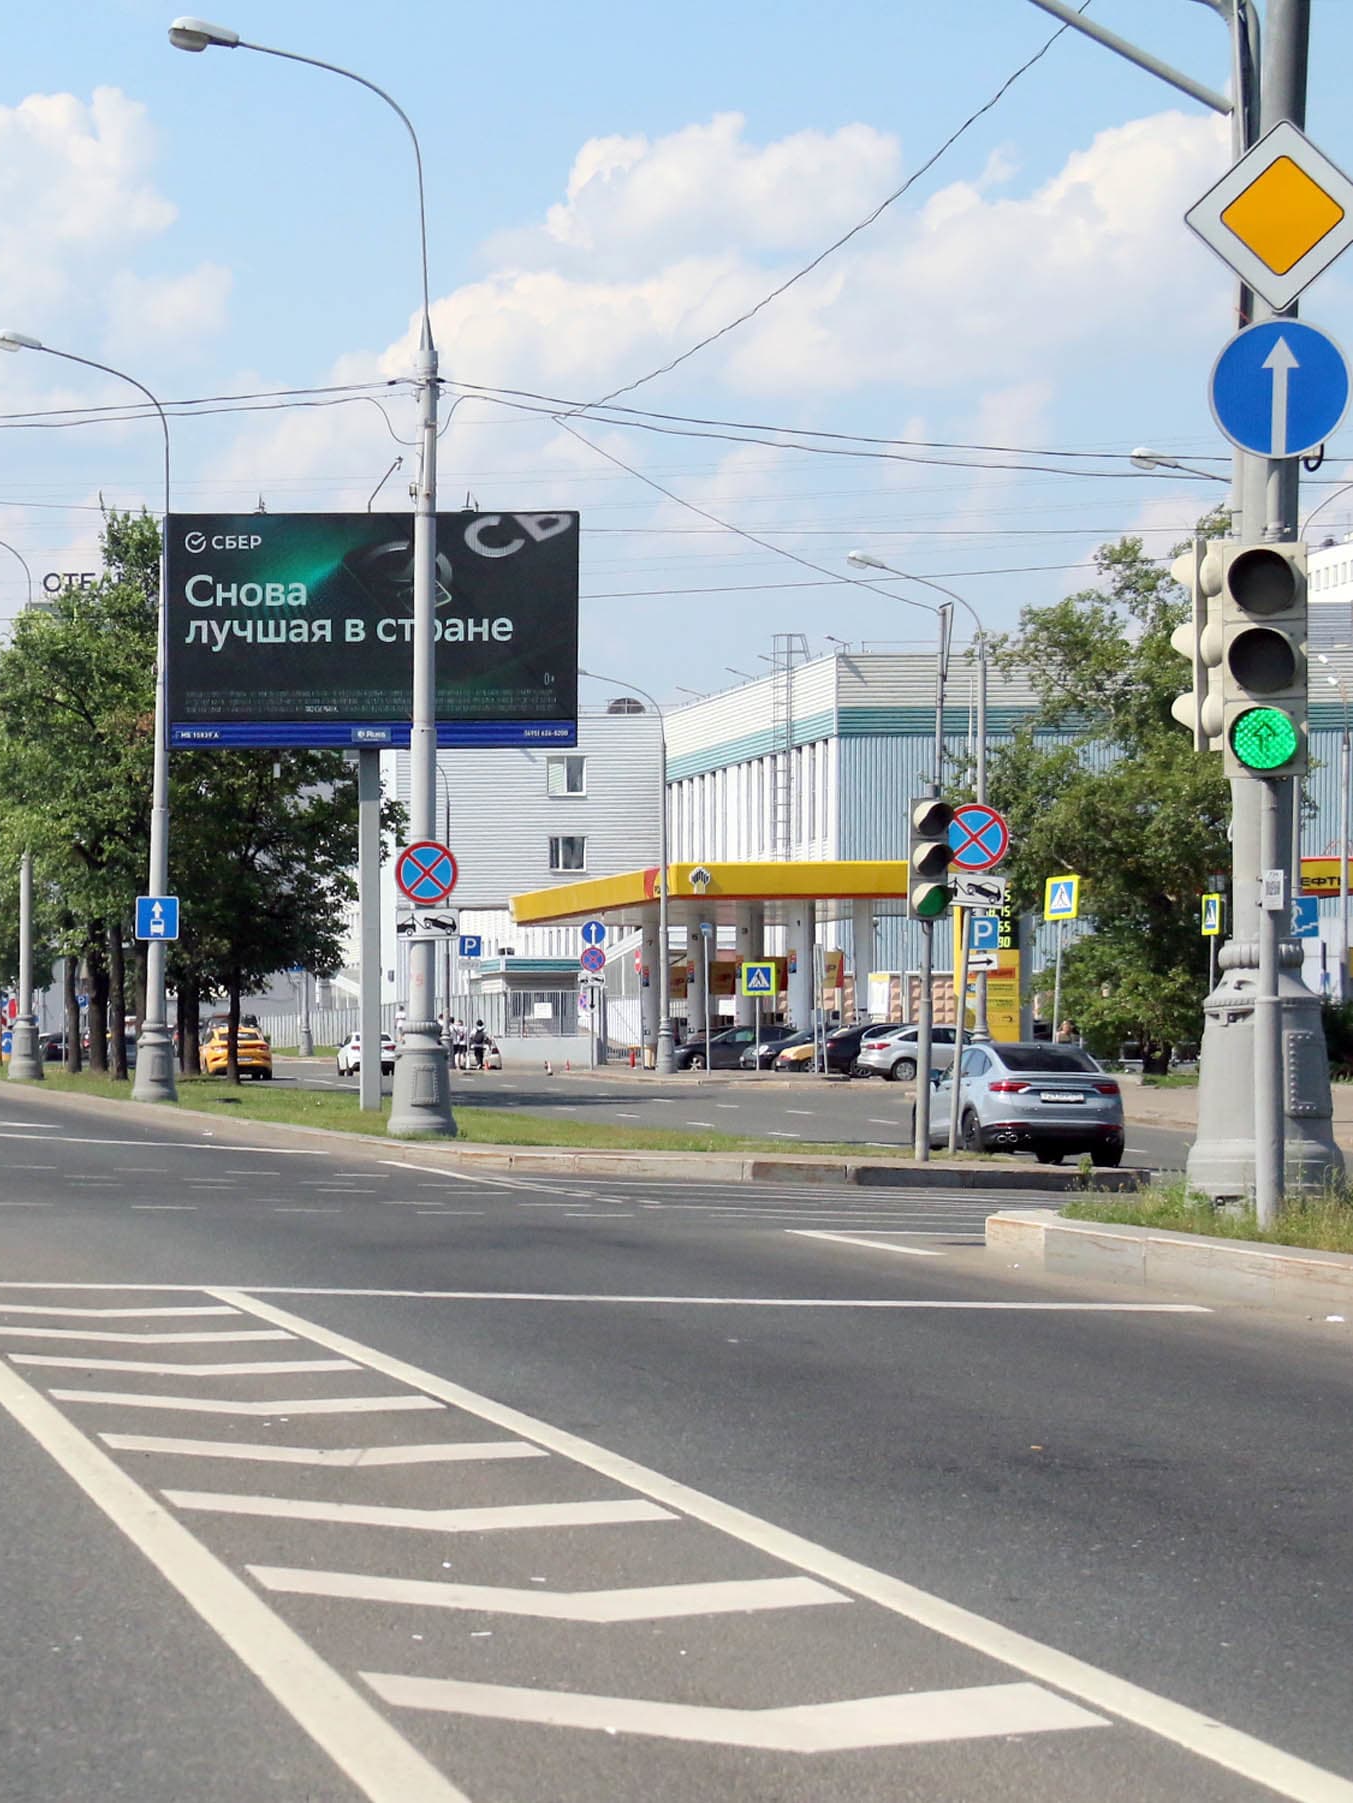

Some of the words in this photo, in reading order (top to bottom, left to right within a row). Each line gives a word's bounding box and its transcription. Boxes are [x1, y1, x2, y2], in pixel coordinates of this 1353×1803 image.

[211, 535, 262, 550] СБЕР
[43, 572, 104, 592] ОТЕ
[184, 574, 308, 608] Снова
[184, 618, 332, 652] лучшая
[344, 618, 366, 642] в
